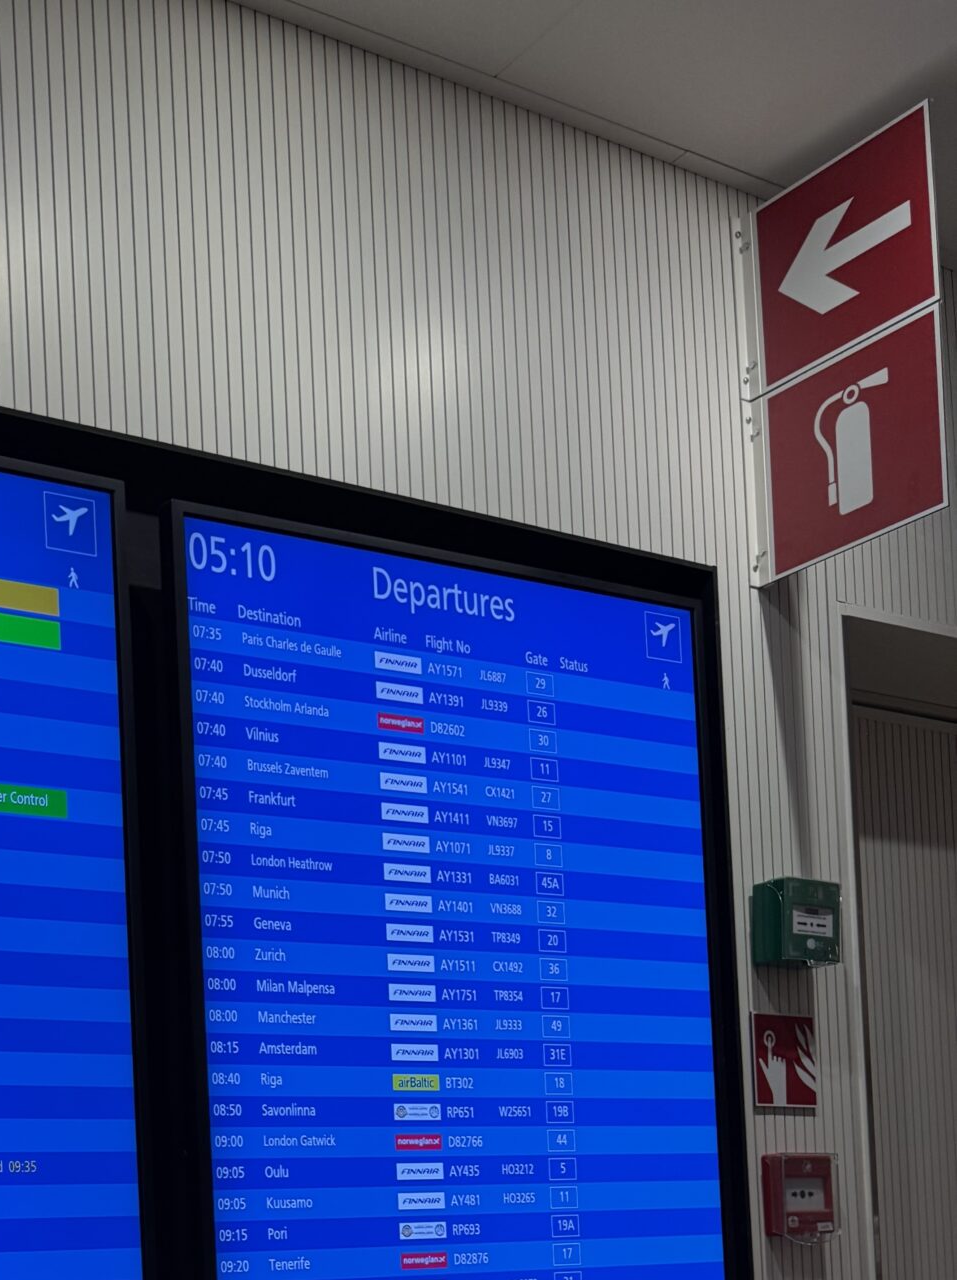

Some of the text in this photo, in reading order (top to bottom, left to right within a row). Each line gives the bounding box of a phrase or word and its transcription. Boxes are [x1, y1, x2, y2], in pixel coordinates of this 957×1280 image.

[188, 531, 276, 582] 05:10
[372, 566, 515, 622] Departures
[187, 596, 589, 673] Time Destination Airline Flight No Gate Status
[192, 624, 546, 690] 07:35 Paris Charles de Gaulle FINNAIR AY1571 JL6887 29
[10, 791, 48, 807] Control
[202, 850, 560, 890] 07:50 London Heathrow FINNAIR AY1331 BA6031 45A
[211, 1040, 566, 1061] 08:15 Amsterdam FINNAIR AY1301 JL6903 31E
[215, 1135, 244, 1148] 09:00
[263, 1134, 299, 1147] London
[299, 1133, 337, 1147] Gatwick
[448, 1135, 483, 1148] D82766
[556, 1133, 568, 1145] 44
[8, 1160, 37, 1173] 09:35
